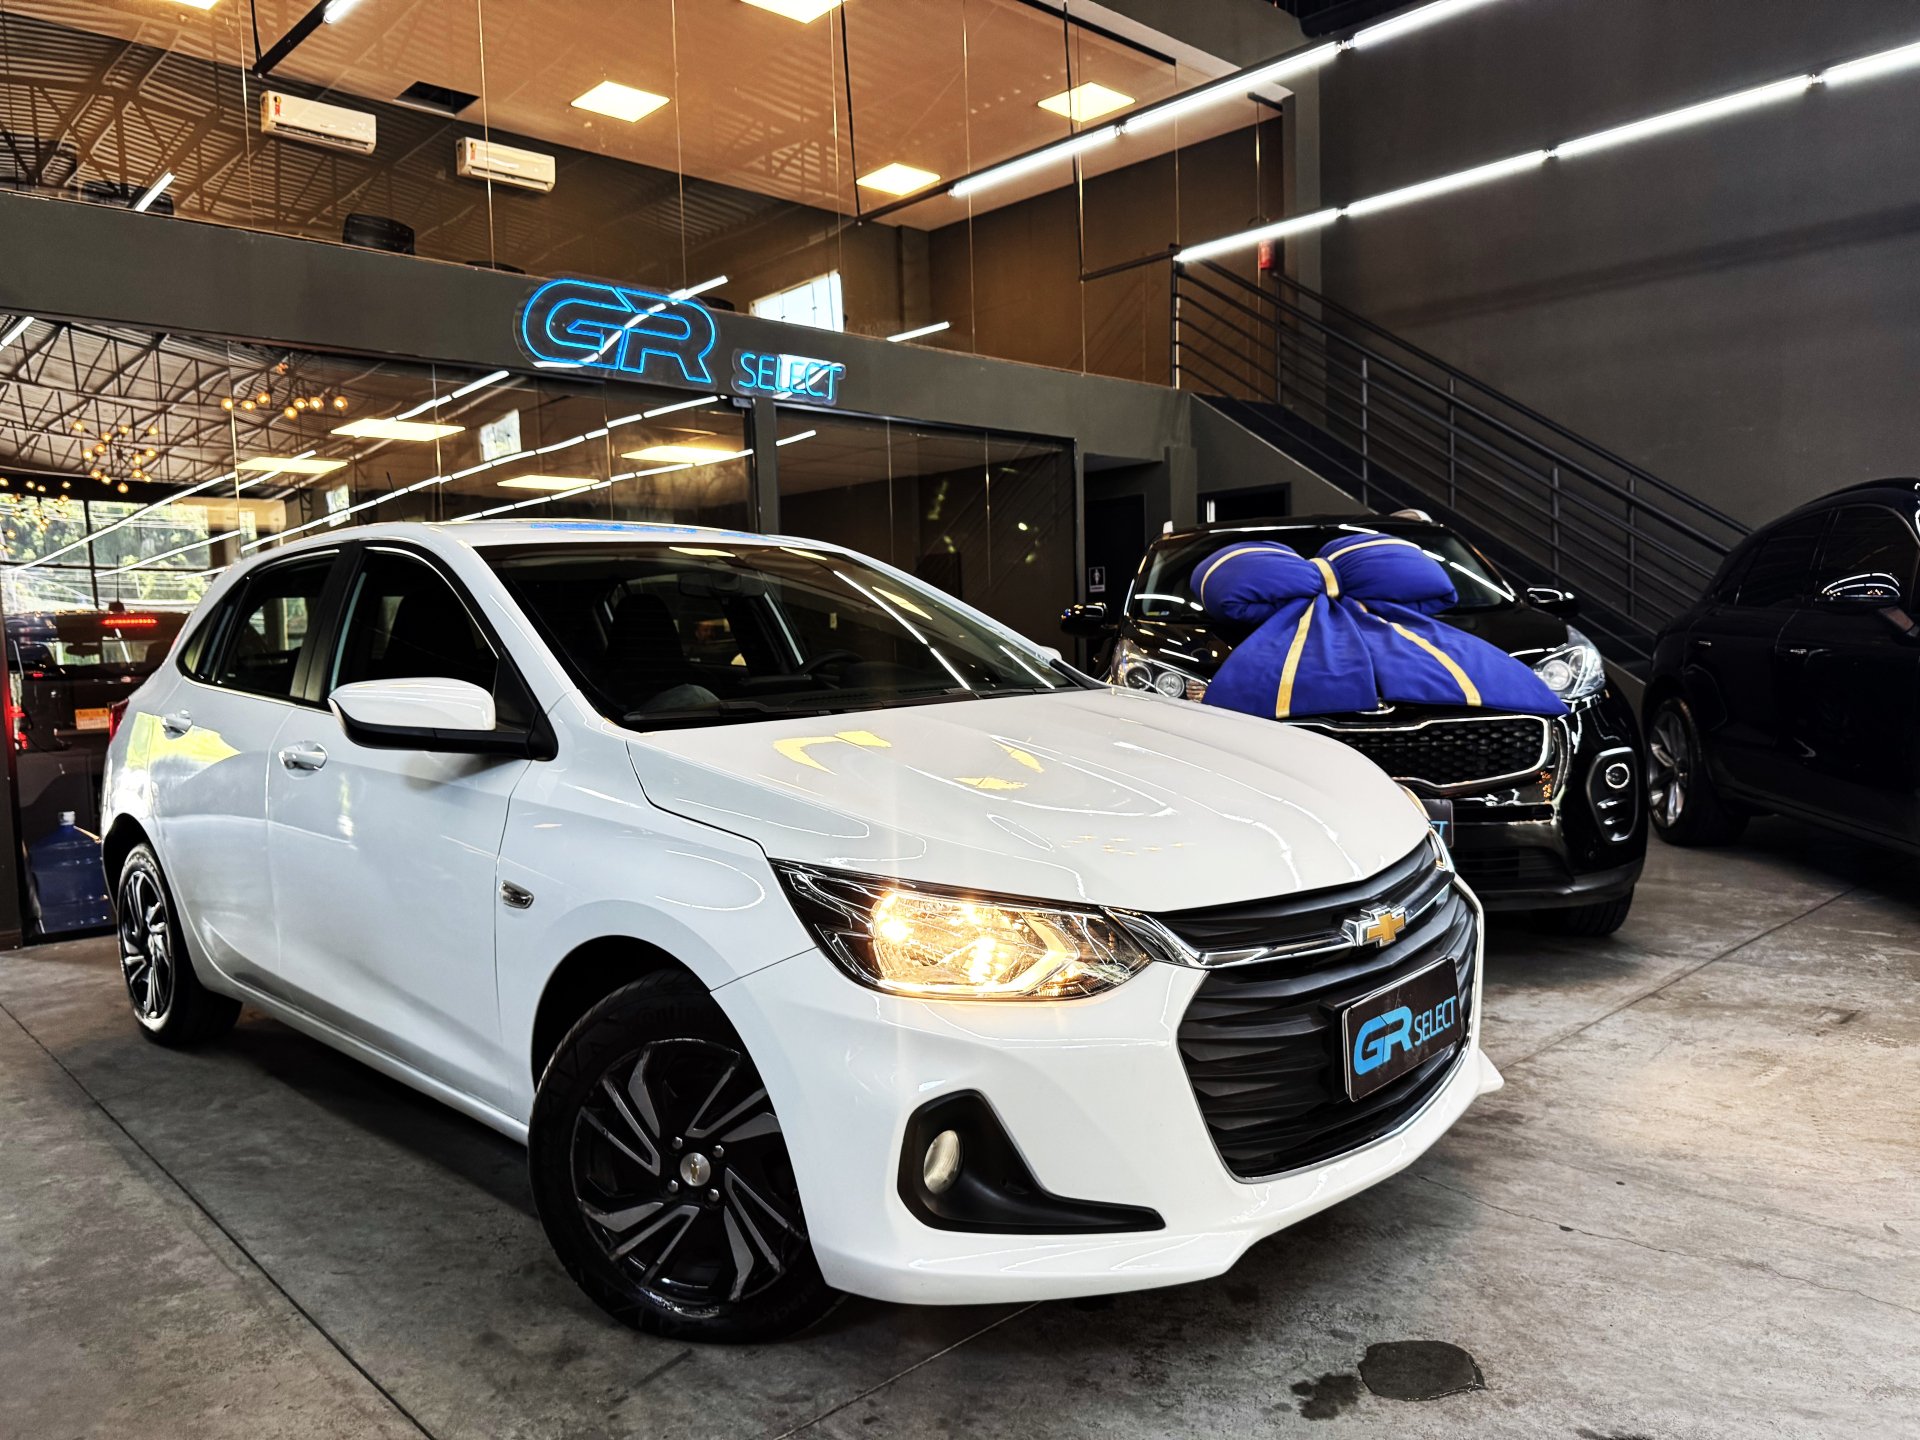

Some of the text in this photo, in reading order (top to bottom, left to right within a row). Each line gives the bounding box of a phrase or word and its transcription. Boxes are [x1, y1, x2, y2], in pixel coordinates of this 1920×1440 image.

[523, 279, 843, 400] GR SELECT
[1354, 996, 1456, 1075] GR SELECT
